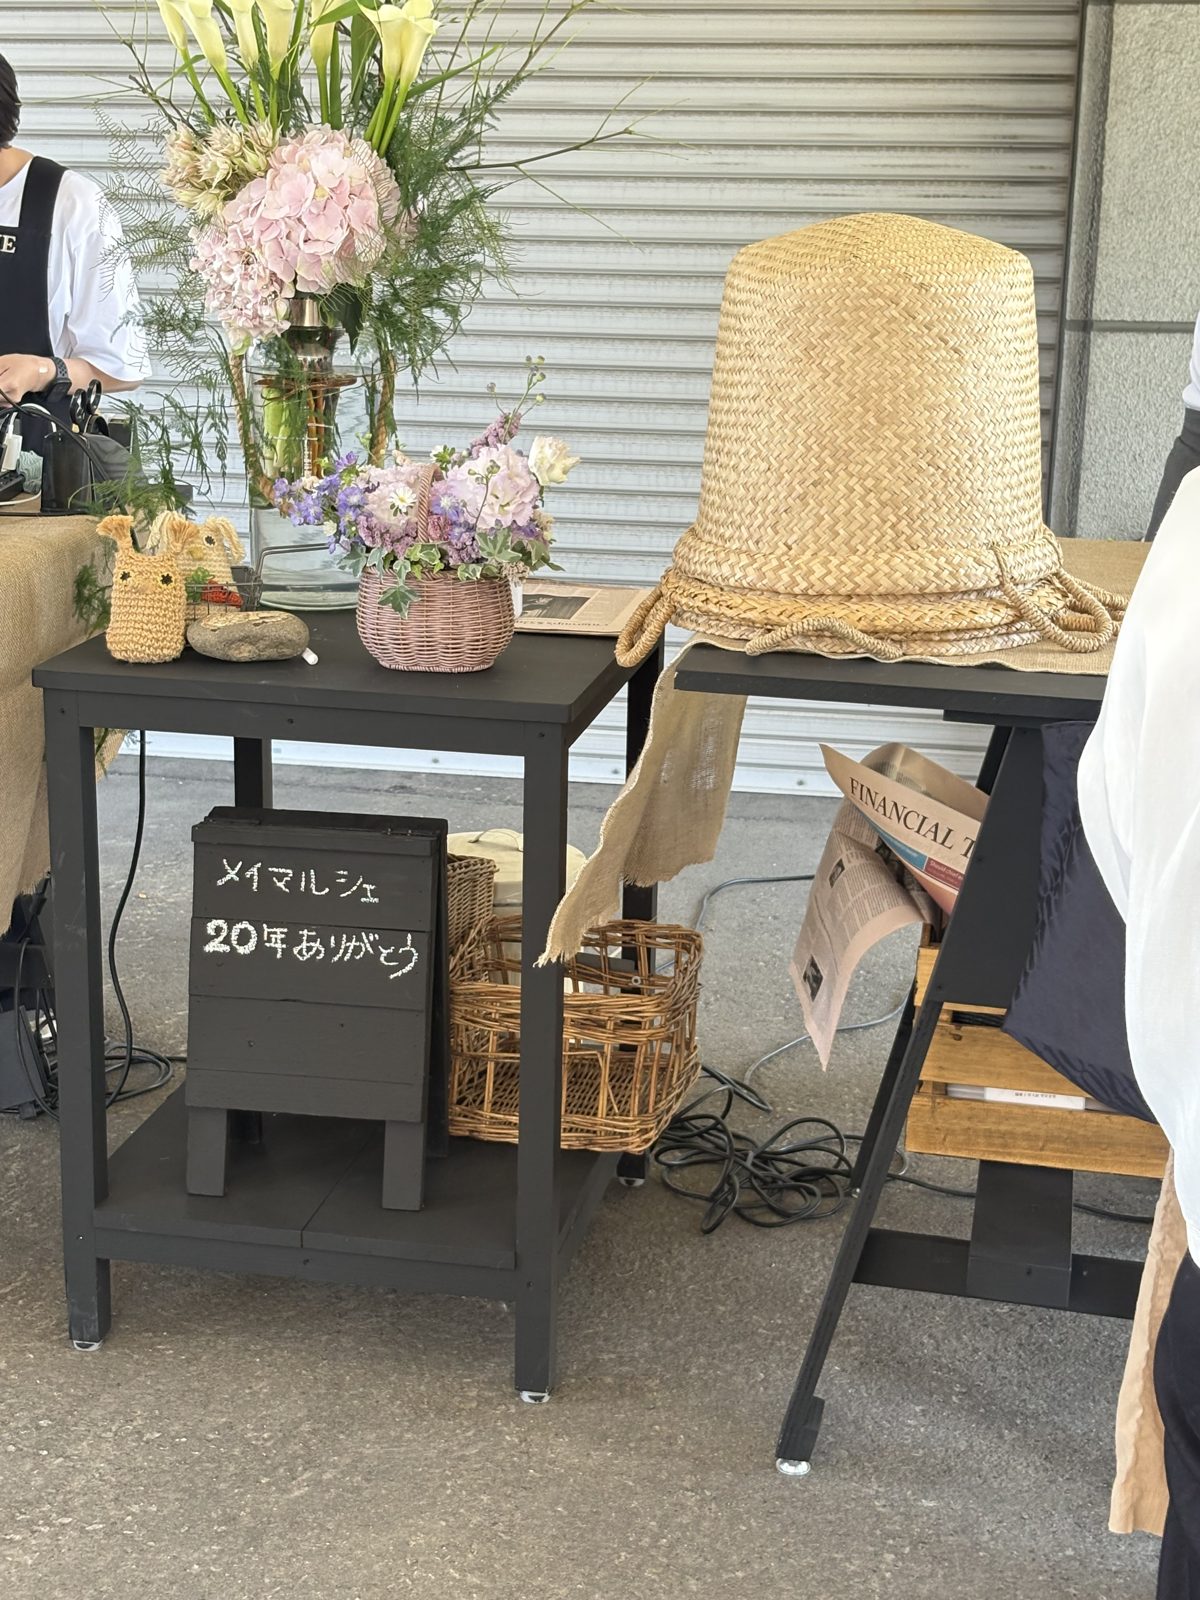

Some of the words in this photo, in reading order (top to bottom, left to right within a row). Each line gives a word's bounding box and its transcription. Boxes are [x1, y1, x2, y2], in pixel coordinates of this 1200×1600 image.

[0, 234, 16, 253] E
[849, 777, 954, 850] FINANCIAL
[216, 858, 380, 903] メイマルシェ
[203, 919, 419, 979] 20年ありがとう
